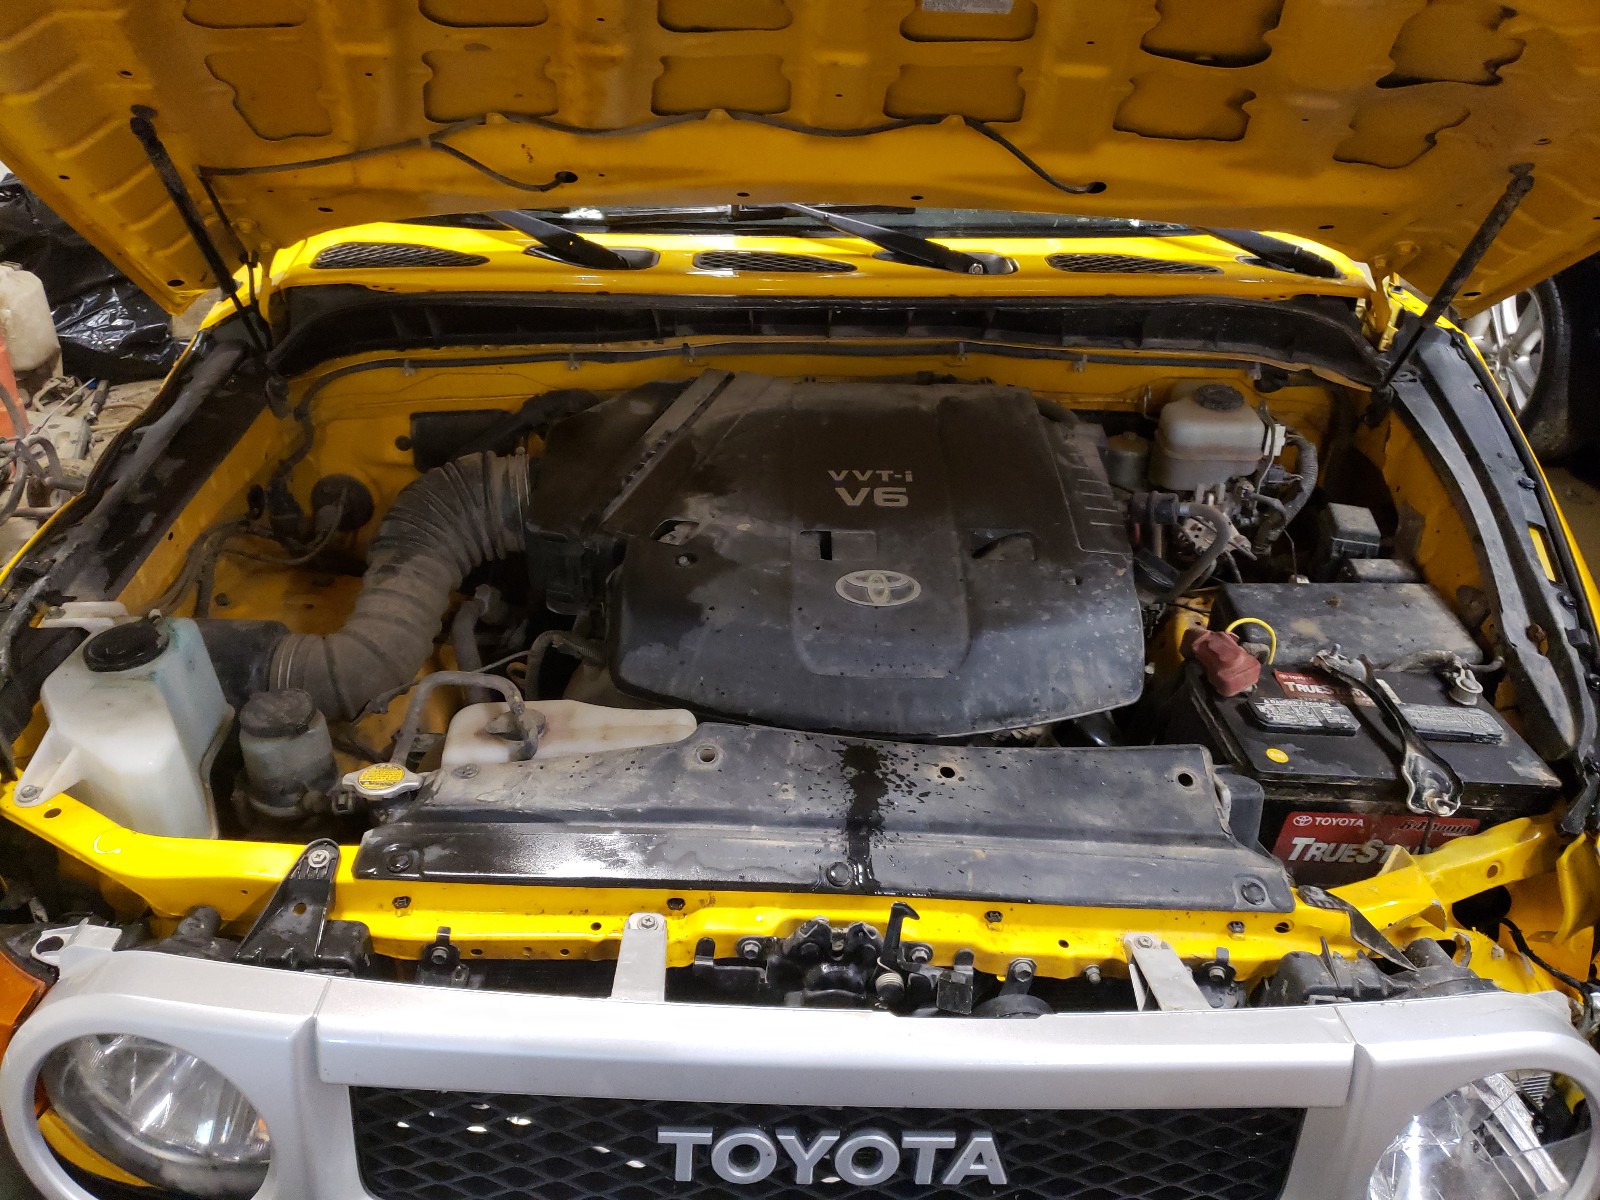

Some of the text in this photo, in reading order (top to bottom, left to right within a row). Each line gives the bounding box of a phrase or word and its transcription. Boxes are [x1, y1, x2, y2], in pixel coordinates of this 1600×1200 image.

[827, 469, 913, 483] VVT-i
[834, 486, 909, 507] V6
[1315, 816, 1364, 827] TOYOTA
[1288, 837, 1400, 864] TRUEST
[657, 1126, 1008, 1186] TOYOTA
